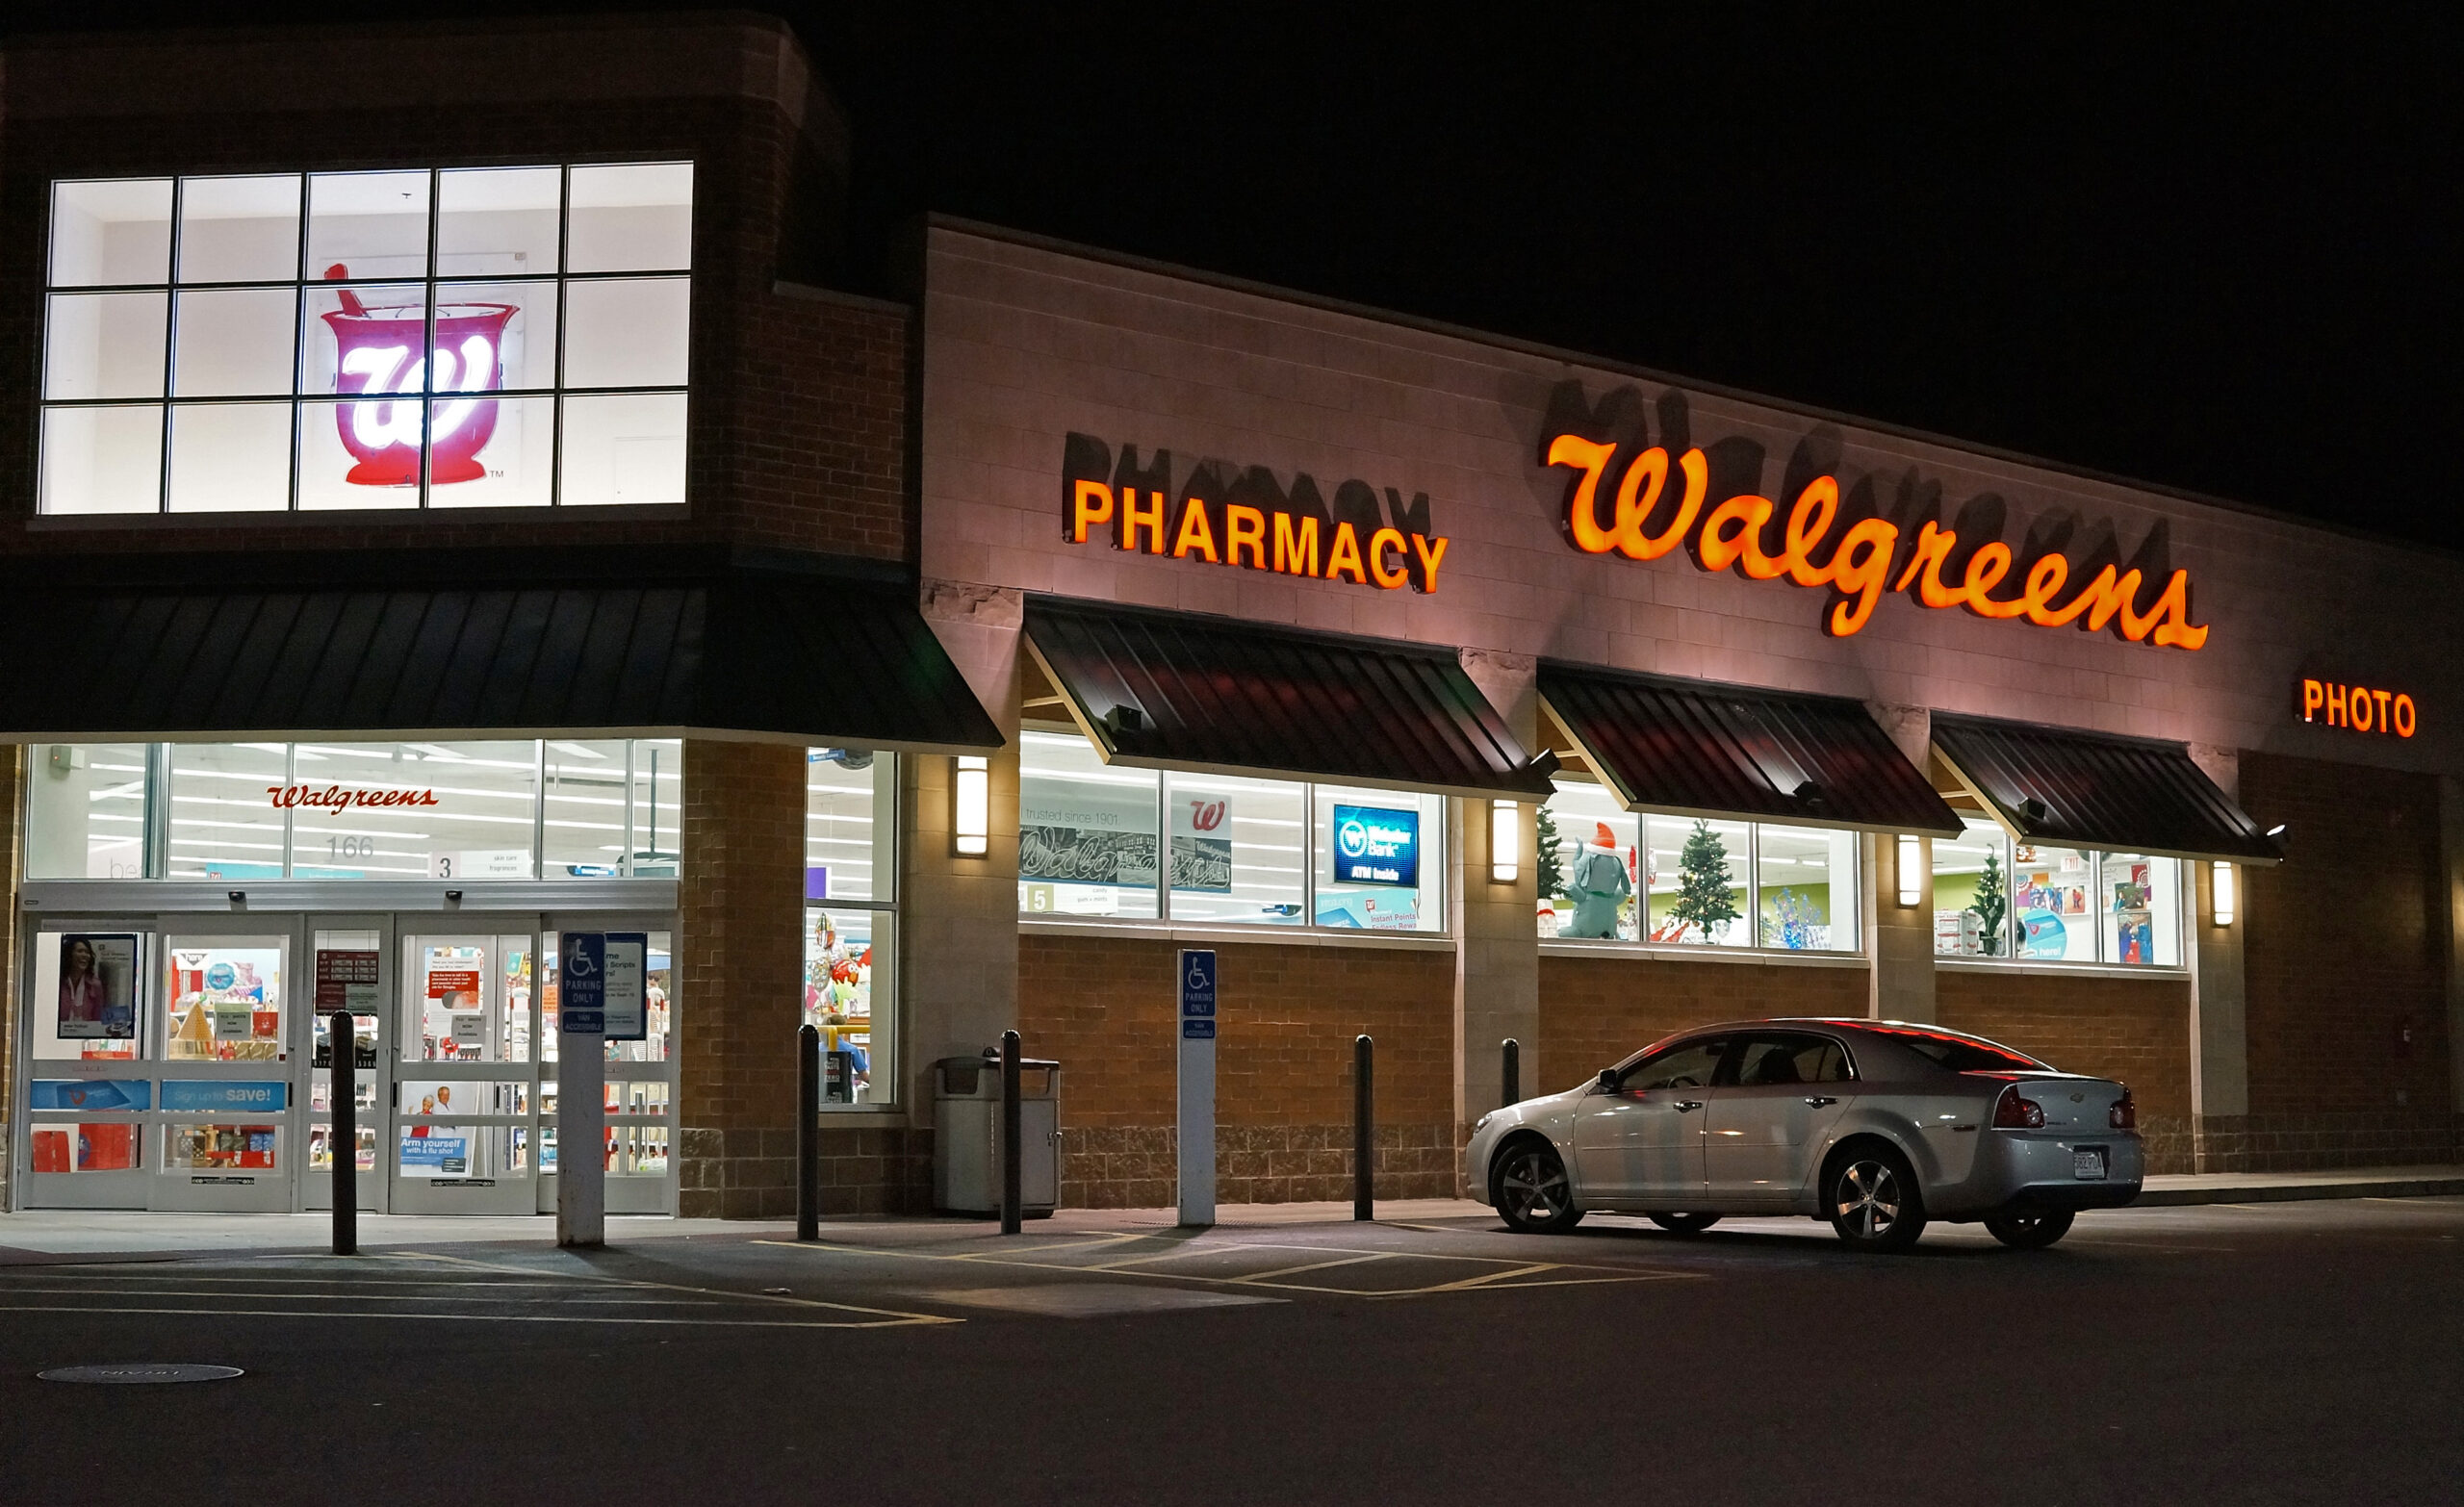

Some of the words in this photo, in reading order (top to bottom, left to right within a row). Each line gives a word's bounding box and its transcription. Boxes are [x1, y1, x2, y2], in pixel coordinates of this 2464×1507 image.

[342, 335, 494, 449] W
[1073, 478, 1449, 594] PHARMACY
[1548, 433, 2209, 651] Walgreens
[2302, 678, 2416, 738] PHOTO
[267, 784, 439, 815] Walgreens
[1026, 808, 1062, 822] trusted
[1065, 810, 1091, 824] since
[1191, 800, 1225, 831] W
[325, 835, 373, 858] 166
[439, 857, 451, 879] 3
[2065, 856, 2079, 870] EXIT
[1351, 865, 1372, 879] ATM
[1373, 867, 1399, 881] Inside
[1034, 889, 1046, 910] 5
[1371, 914, 1393, 923] Instant
[1394, 913, 1417, 922] Points
[2039, 946, 2061, 957] here!
[565, 980, 602, 990] PARKING
[573, 992, 594, 1003] ONLY
[1185, 992, 1214, 1002] PARKING
[1191, 1004, 1208, 1012] ONLY
[175, 1091, 195, 1103] Sign
[198, 1092, 212, 1102] up
[214, 1091, 222, 1100] to
[226, 1088, 270, 1101] save!
[400, 1138, 421, 1147] Arm
[423, 1139, 461, 1148] yourself
